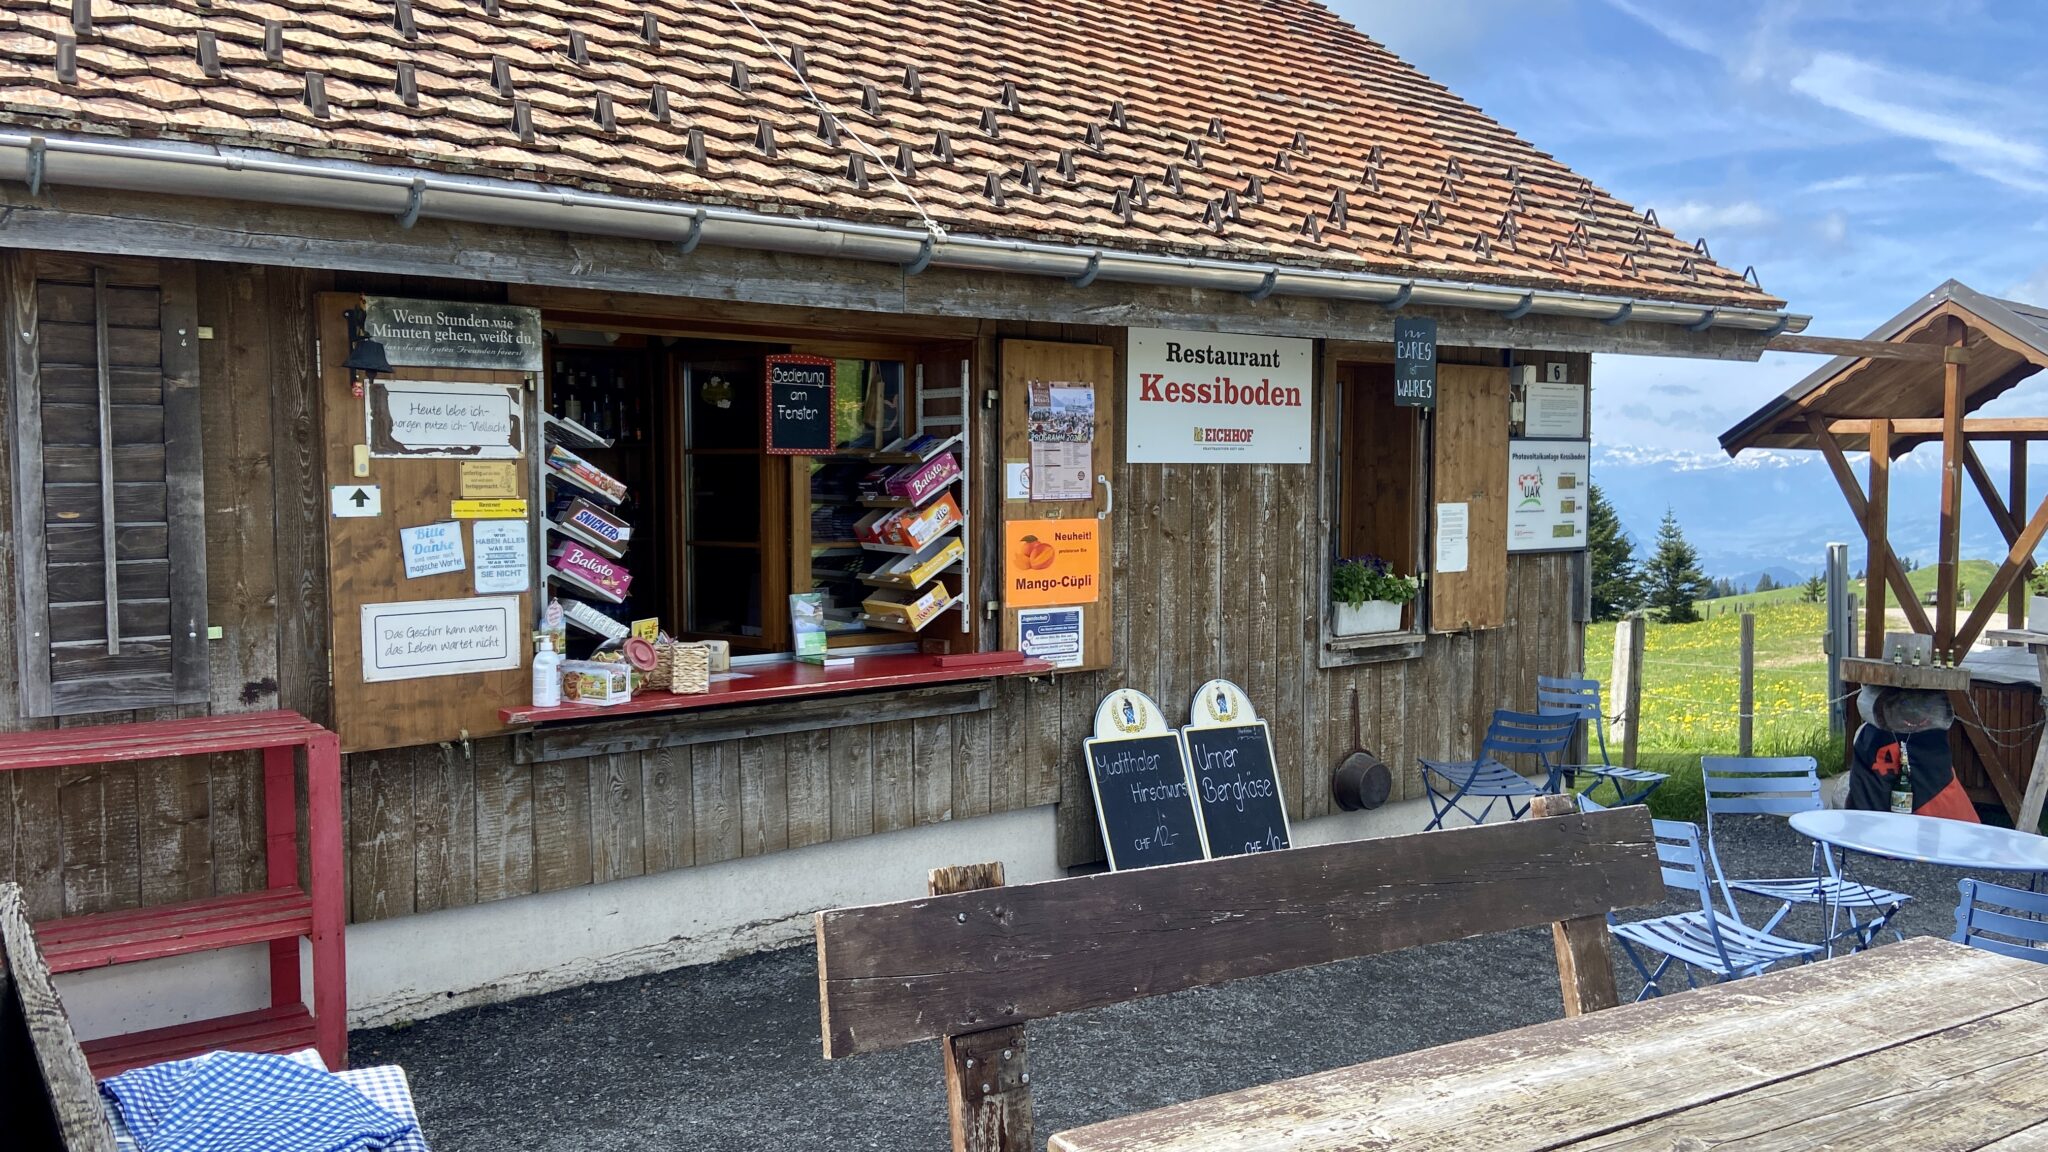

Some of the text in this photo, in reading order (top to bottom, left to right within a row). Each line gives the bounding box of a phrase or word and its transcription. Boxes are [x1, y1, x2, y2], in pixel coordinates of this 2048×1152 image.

[392, 309, 514, 330] Wenn Stunden wie
[372, 323, 536, 346] Minuten gehen, weißt du,
[431, 346, 454, 355] guten
[456, 345, 496, 355] Freunden
[1166, 342, 1280, 368] Restaurant
[1397, 340, 1432, 361] BARES
[773, 367, 824, 389] Bedienung
[1554, 365, 1560, 381] 6
[790, 391, 807, 400] am
[1139, 373, 1302, 406] Kessiboden
[1396, 379, 1432, 399] WAHRES
[409, 402, 490, 416] Heute lebe ich-
[777, 404, 818, 420] Fenster
[424, 421, 448, 433] putze
[450, 420, 467, 430] ich-
[1205, 428, 1254, 442] EICHHOF
[1512, 452, 1559, 461] Photovoltaikanlage
[912, 463, 942, 496] Balisto
[1524, 485, 1541, 498] UAK
[415, 527, 445, 539] Bitte
[575, 510, 620, 541] SNICKERS
[1055, 532, 1092, 541] Neuheit!
[413, 541, 454, 555] Danke
[410, 561, 438, 573] magische
[567, 548, 614, 577] Balisto
[480, 569, 522, 578] SIE NICHT
[1016, 575, 1092, 592] Mango-Cüpli
[384, 623, 498, 640] Das Geschirr kann warten
[385, 635, 500, 657] das Leben wartet nicht
[1195, 743, 1239, 771] Urner
[1202, 771, 1273, 813] Bergkäse
[1134, 836, 1151, 851] CHF
[1244, 841, 1262, 855] CHF
